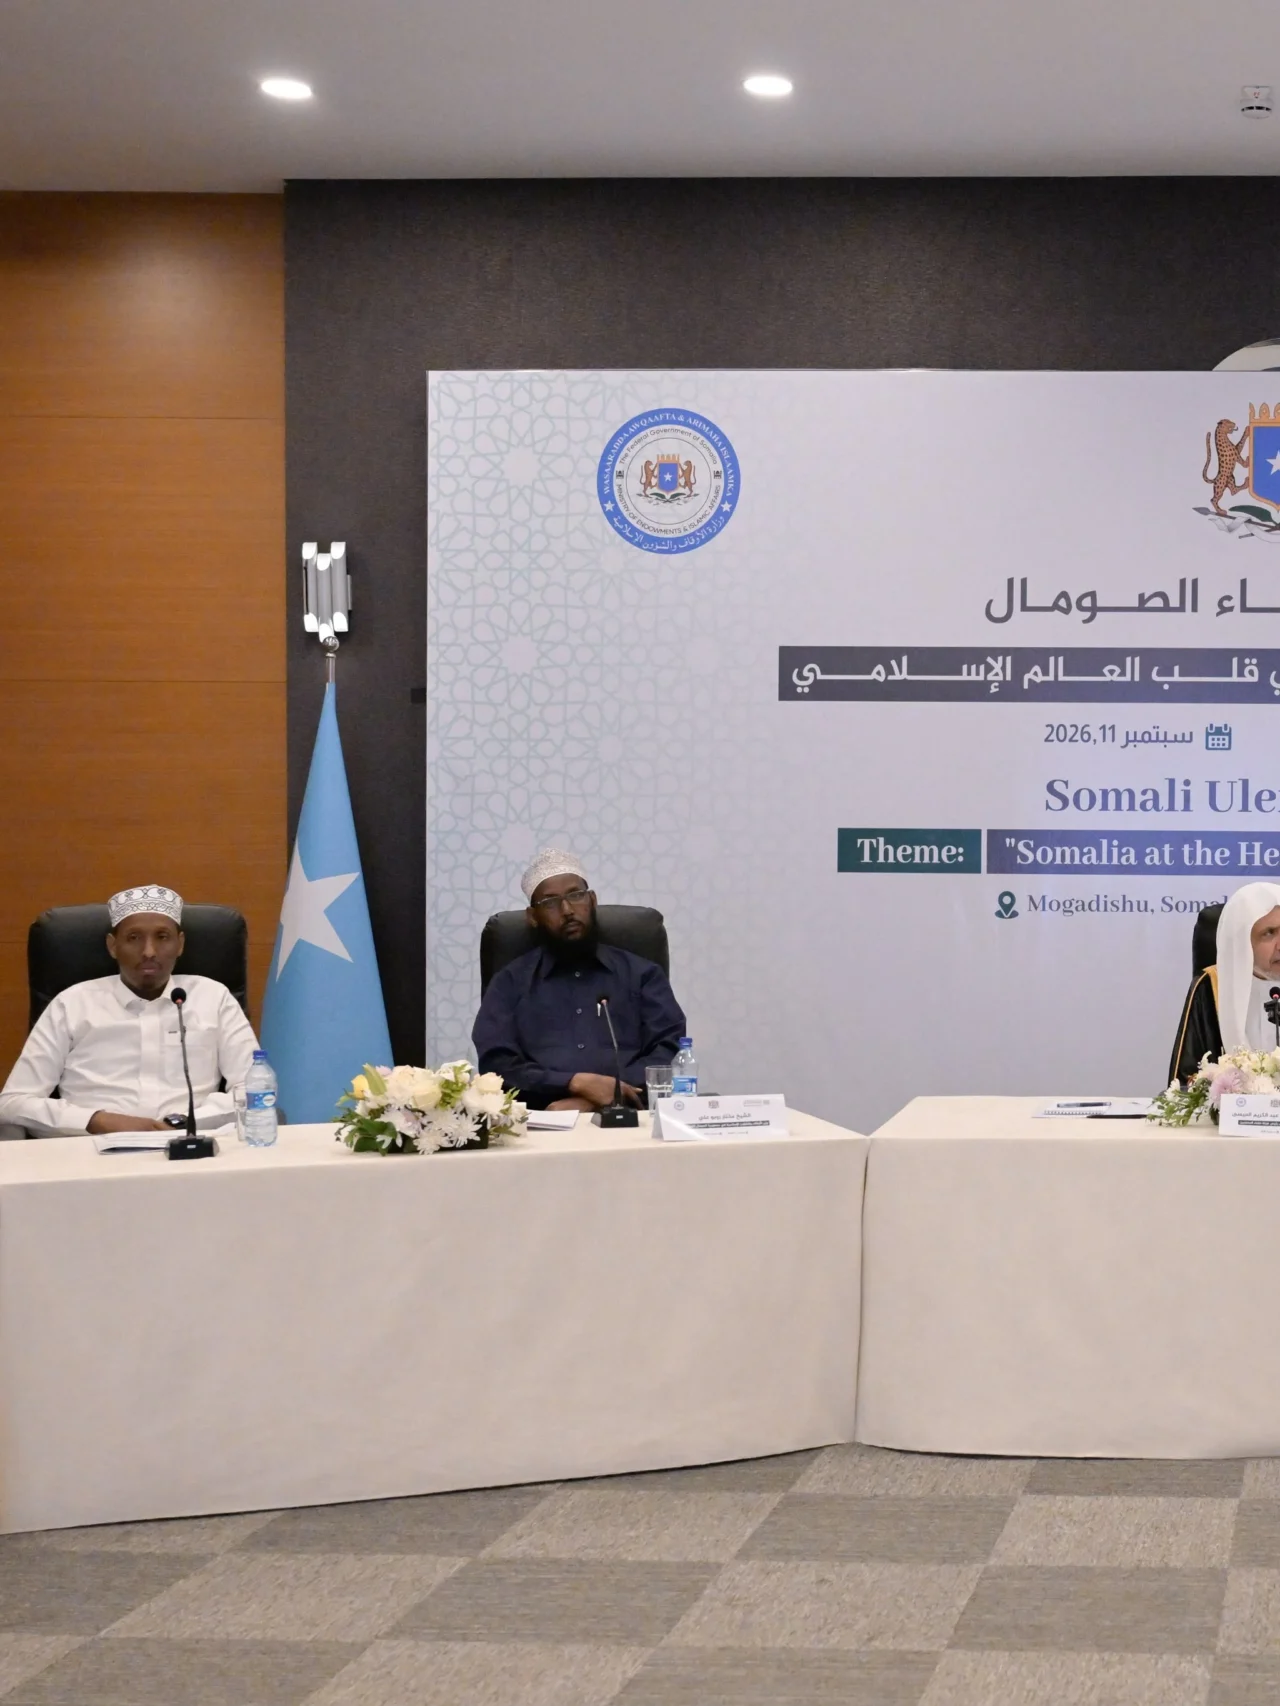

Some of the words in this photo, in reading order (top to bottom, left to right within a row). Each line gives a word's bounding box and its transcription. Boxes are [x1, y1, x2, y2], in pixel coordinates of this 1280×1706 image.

[619, 452, 629, 464] The
[627, 433, 649, 453] Federal
[649, 428, 692, 438] Government
[699, 440, 718, 464] Somalia
[678, 414, 686, 422] &
[687, 417, 722, 447] ARIMAHA
[616, 484, 631, 512] MINISTRY
[628, 511, 638, 521] OF
[636, 519, 682, 535] ENDOWMENTS
[688, 509, 710, 530] ISLAMIC
[708, 485, 721, 511] AFFAIRS
[984, 576, 1198, 625] الصومال
[792, 655, 1012, 694] الإسلامي
[1023, 655, 1140, 690] العالم
[1151, 656, 1259, 691] قلب
[1120, 725, 1194, 748] سبتمبر
[1046, 777, 1194, 813] Somali
[857, 836, 964, 865] Theme:
[1005, 838, 1138, 866] "Somalia
[1144, 842, 1175, 866] at
[1182, 839, 1231, 867] the
[1027, 894, 1155, 917] Mogadishu,
